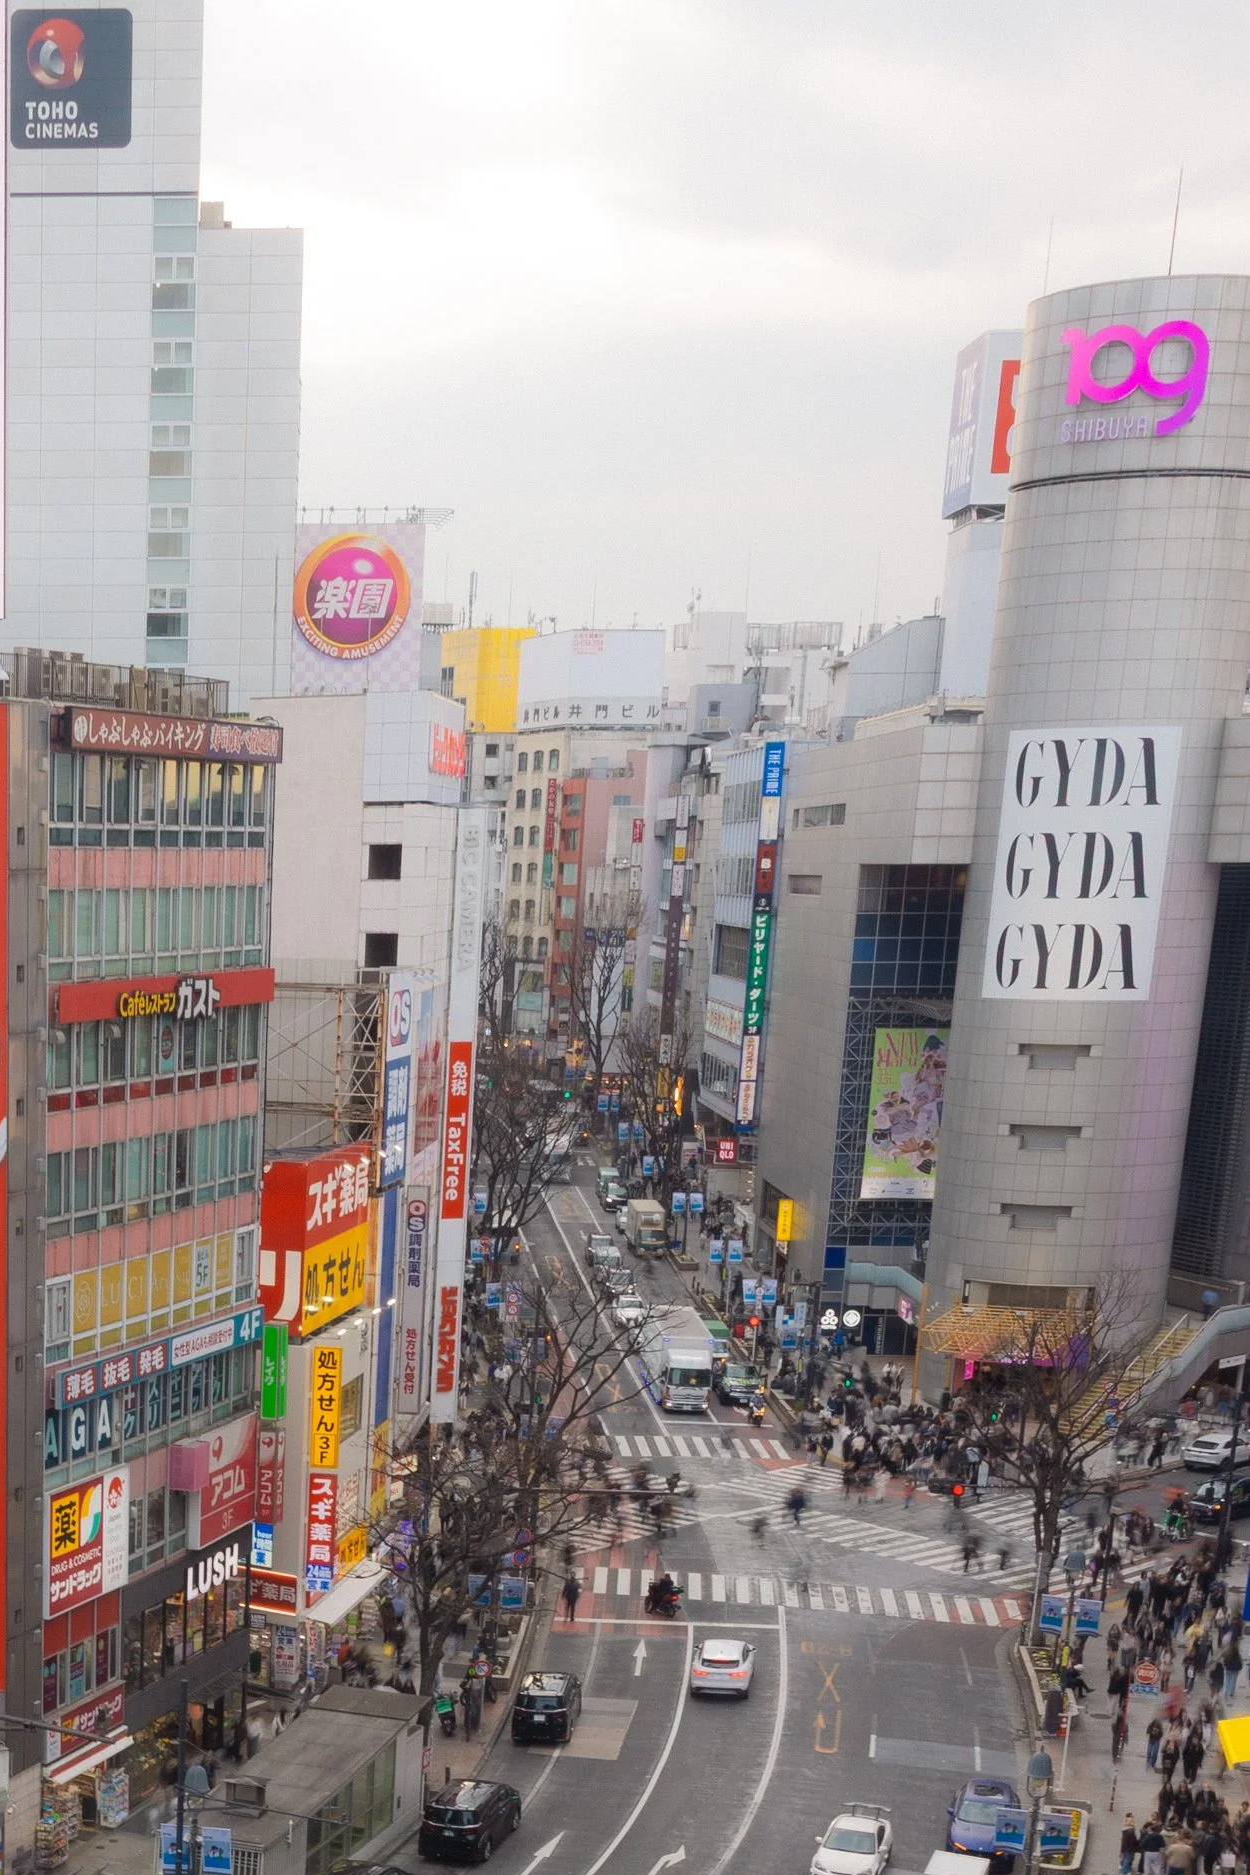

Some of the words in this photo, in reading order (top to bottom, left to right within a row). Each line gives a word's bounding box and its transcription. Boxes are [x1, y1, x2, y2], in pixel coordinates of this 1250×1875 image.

[25, 101, 78, 120] TOHO
[25, 123, 99, 139] CINEMAS
[1061, 320, 1210, 436] 109
[1061, 416, 1148, 443] SHIBUYA
[312, 576, 394, 619] 楽園
[297, 615, 340, 657] EXCITING
[342, 615, 404, 660] AMUSEMENT
[569, 704, 660, 719] 井門ビル
[89, 713, 207, 751] しゃぶしゃぶバイキング
[767, 749, 781, 765] THE
[1015, 737, 1162, 808] GYDA
[766, 768, 780, 793] PRIME
[1006, 831, 1150, 899] GYDA
[995, 924, 1138, 990] GYDA
[177, 979, 221, 1019] ガスト
[451, 1060, 467, 1096] 免税
[446, 1113, 466, 1201] TaxFree
[719, 1150, 734, 1160] QLO
[720, 1141, 734, 1150] UNI
[307, 1164, 369, 1231] スギ薬局
[408, 1200, 427, 1232] OS
[196, 1263, 209, 1288] 5F
[407, 1234, 422, 1288] 調剤薬局
[304, 1244, 364, 1320] 処方せん
[66, 1371, 95, 1401] 薄毛
[103, 1357, 131, 1389] 抜毛
[139, 1345, 165, 1376] 発毛
[240, 1309, 262, 1341] 4F
[404, 1329, 418, 1395] 処方せん受付
[317, 1350, 338, 1432] 処方せん
[320, 1437, 331, 1465] 3F
[211, 1465, 246, 1506] アコム
[261, 1469, 272, 1506] アコム
[54, 1500, 78, 1549] 薬
[221, 1508, 234, 1529] 3F
[309, 1478, 334, 1563] スギ薬局
[50, 1563, 102, 1602] サンドラッグ
[51, 1559, 69, 1577] DRUG
[186, 1543, 240, 1601] LUSH
